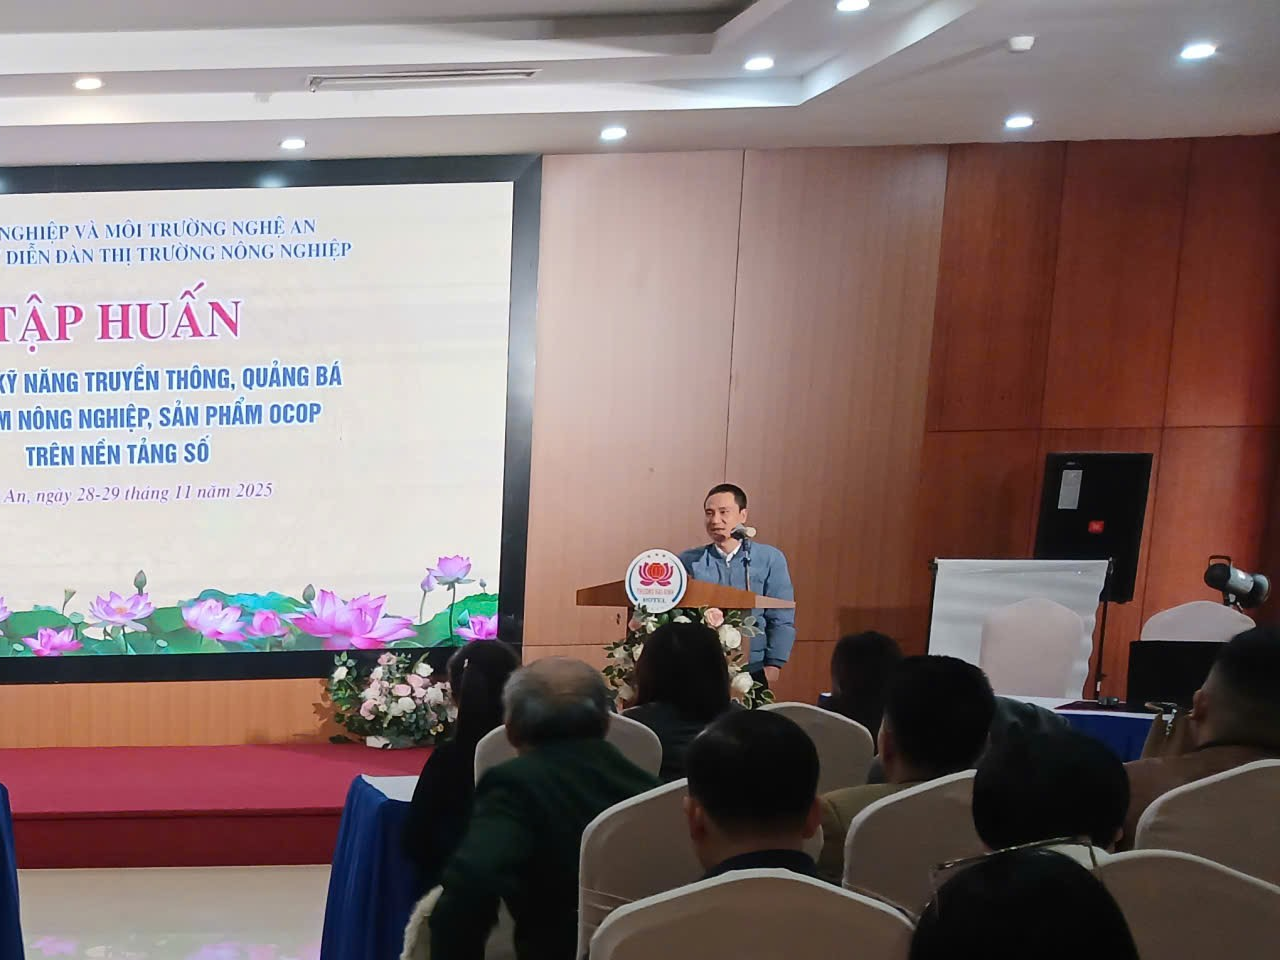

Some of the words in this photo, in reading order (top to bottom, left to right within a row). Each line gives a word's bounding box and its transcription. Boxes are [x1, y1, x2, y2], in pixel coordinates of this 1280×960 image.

[0, 221, 69, 245] NGHIỆP
[75, 220, 98, 239] VÀ
[105, 219, 142, 239] MÔI
[148, 218, 226, 237] TRƯỜNG
[232, 216, 285, 238] NGHỆ
[290, 219, 317, 234] AN
[6, 242, 51, 265] DIỄN
[55, 244, 94, 264] ĐÀN
[99, 248, 131, 266] THỊ
[137, 242, 215, 262] TRƯỜNG
[221, 241, 274, 260] NÔNG
[280, 239, 352, 261] NGHIỆP
[97, 282, 241, 340] HUẤN
[24, 368, 79, 393] NĂNG
[85, 364, 159, 392] TRUYỀN
[166, 365, 236, 391] THÔNG,
[243, 360, 309, 388] QUẢNG
[316, 360, 342, 387] BÁ
[18, 406, 71, 430] NÔNG
[78, 404, 153, 432] NGHIỆP,
[159, 399, 199, 427] SẢN
[205, 396, 263, 426] PHẨM
[269, 403, 322, 425] OCOP
[25, 442, 75, 467] TRÊN
[81, 438, 120, 465] NỀN
[127, 437, 177, 464] TẢNG
[183, 435, 211, 463] SỐ
[3, 488, 31, 504] An,
[35, 487, 72, 505] ngày
[77, 486, 120, 502] 28-29
[124, 485, 169, 504] tháng
[175, 484, 192, 499] 11
[196, 484, 231, 499] năm
[235, 482, 273, 498] 2025
